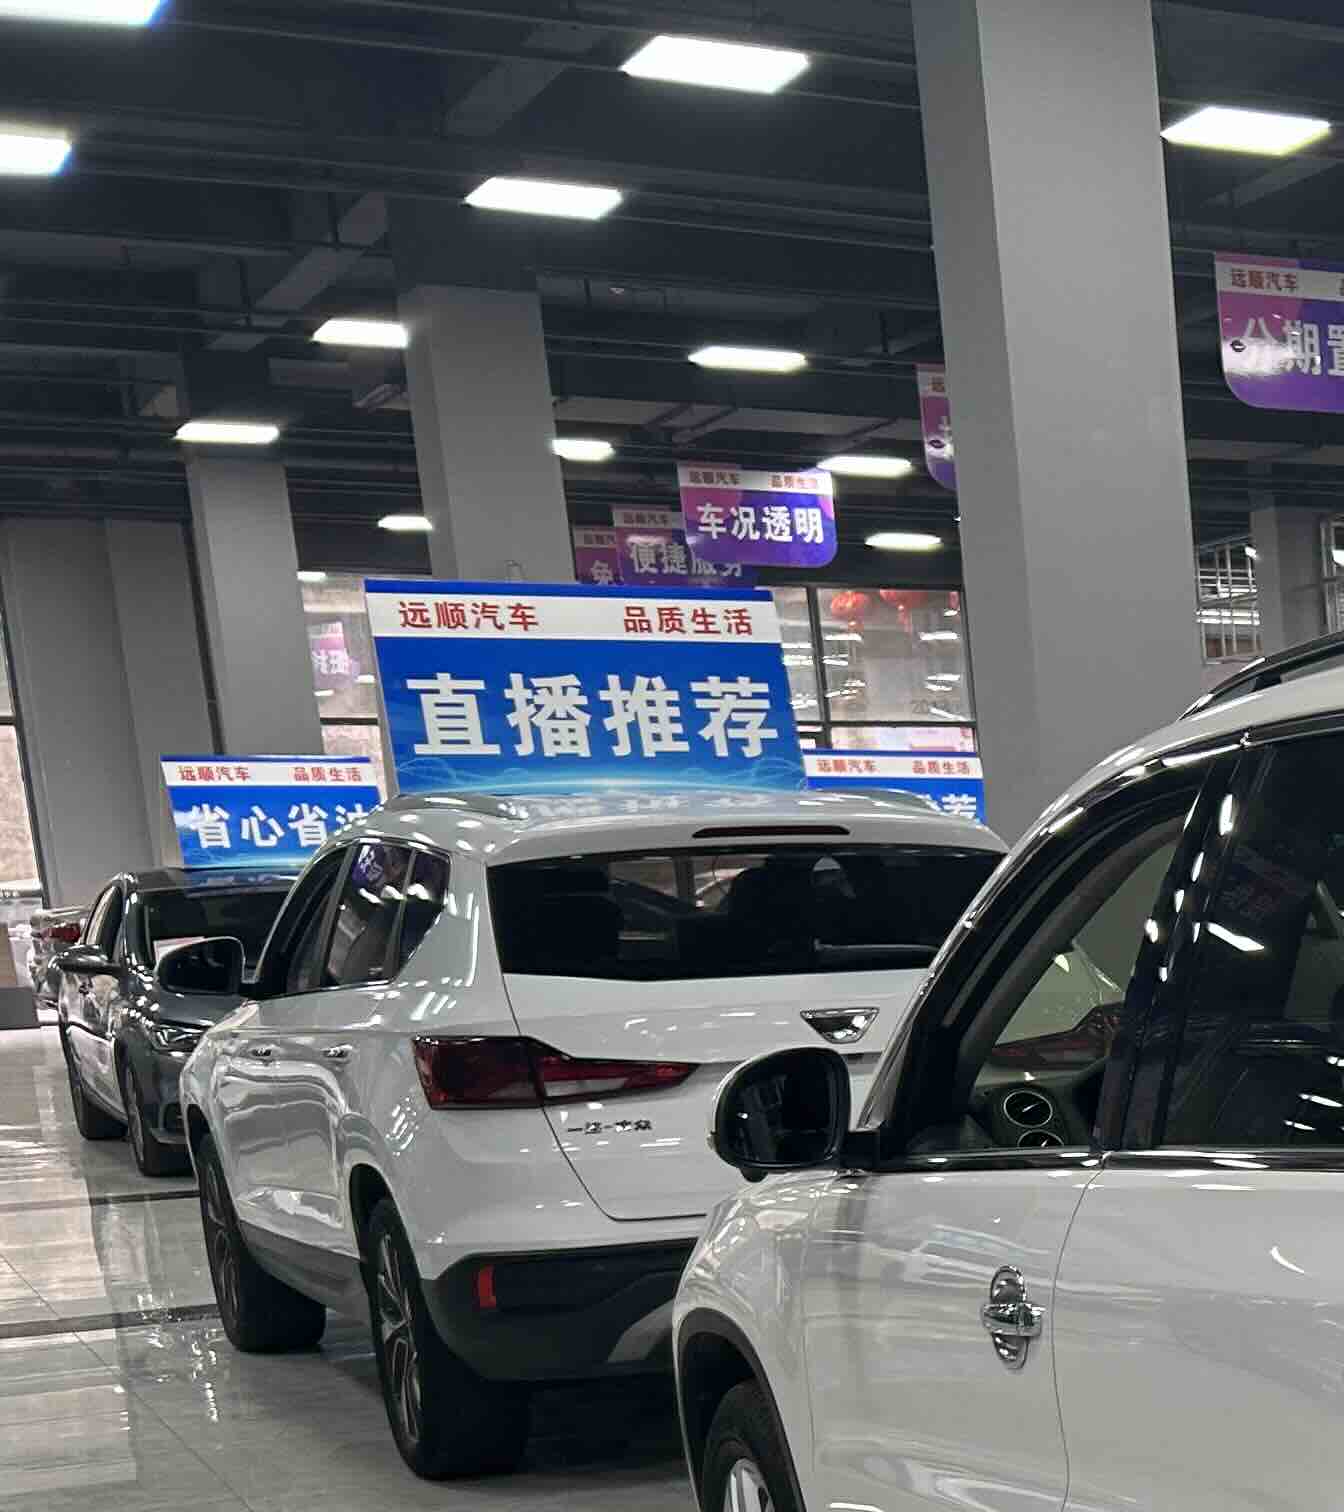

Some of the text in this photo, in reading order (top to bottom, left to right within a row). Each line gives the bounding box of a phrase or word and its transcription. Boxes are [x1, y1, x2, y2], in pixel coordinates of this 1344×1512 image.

[1231, 268, 1298, 292] 远顺汽车
[696, 502, 825, 544] 车况透明
[398, 601, 753, 636] 远顺汽车 品质生活
[406, 672, 779, 758] 直播推荐
[178, 765, 362, 782] 远顺汽车 品质生活
